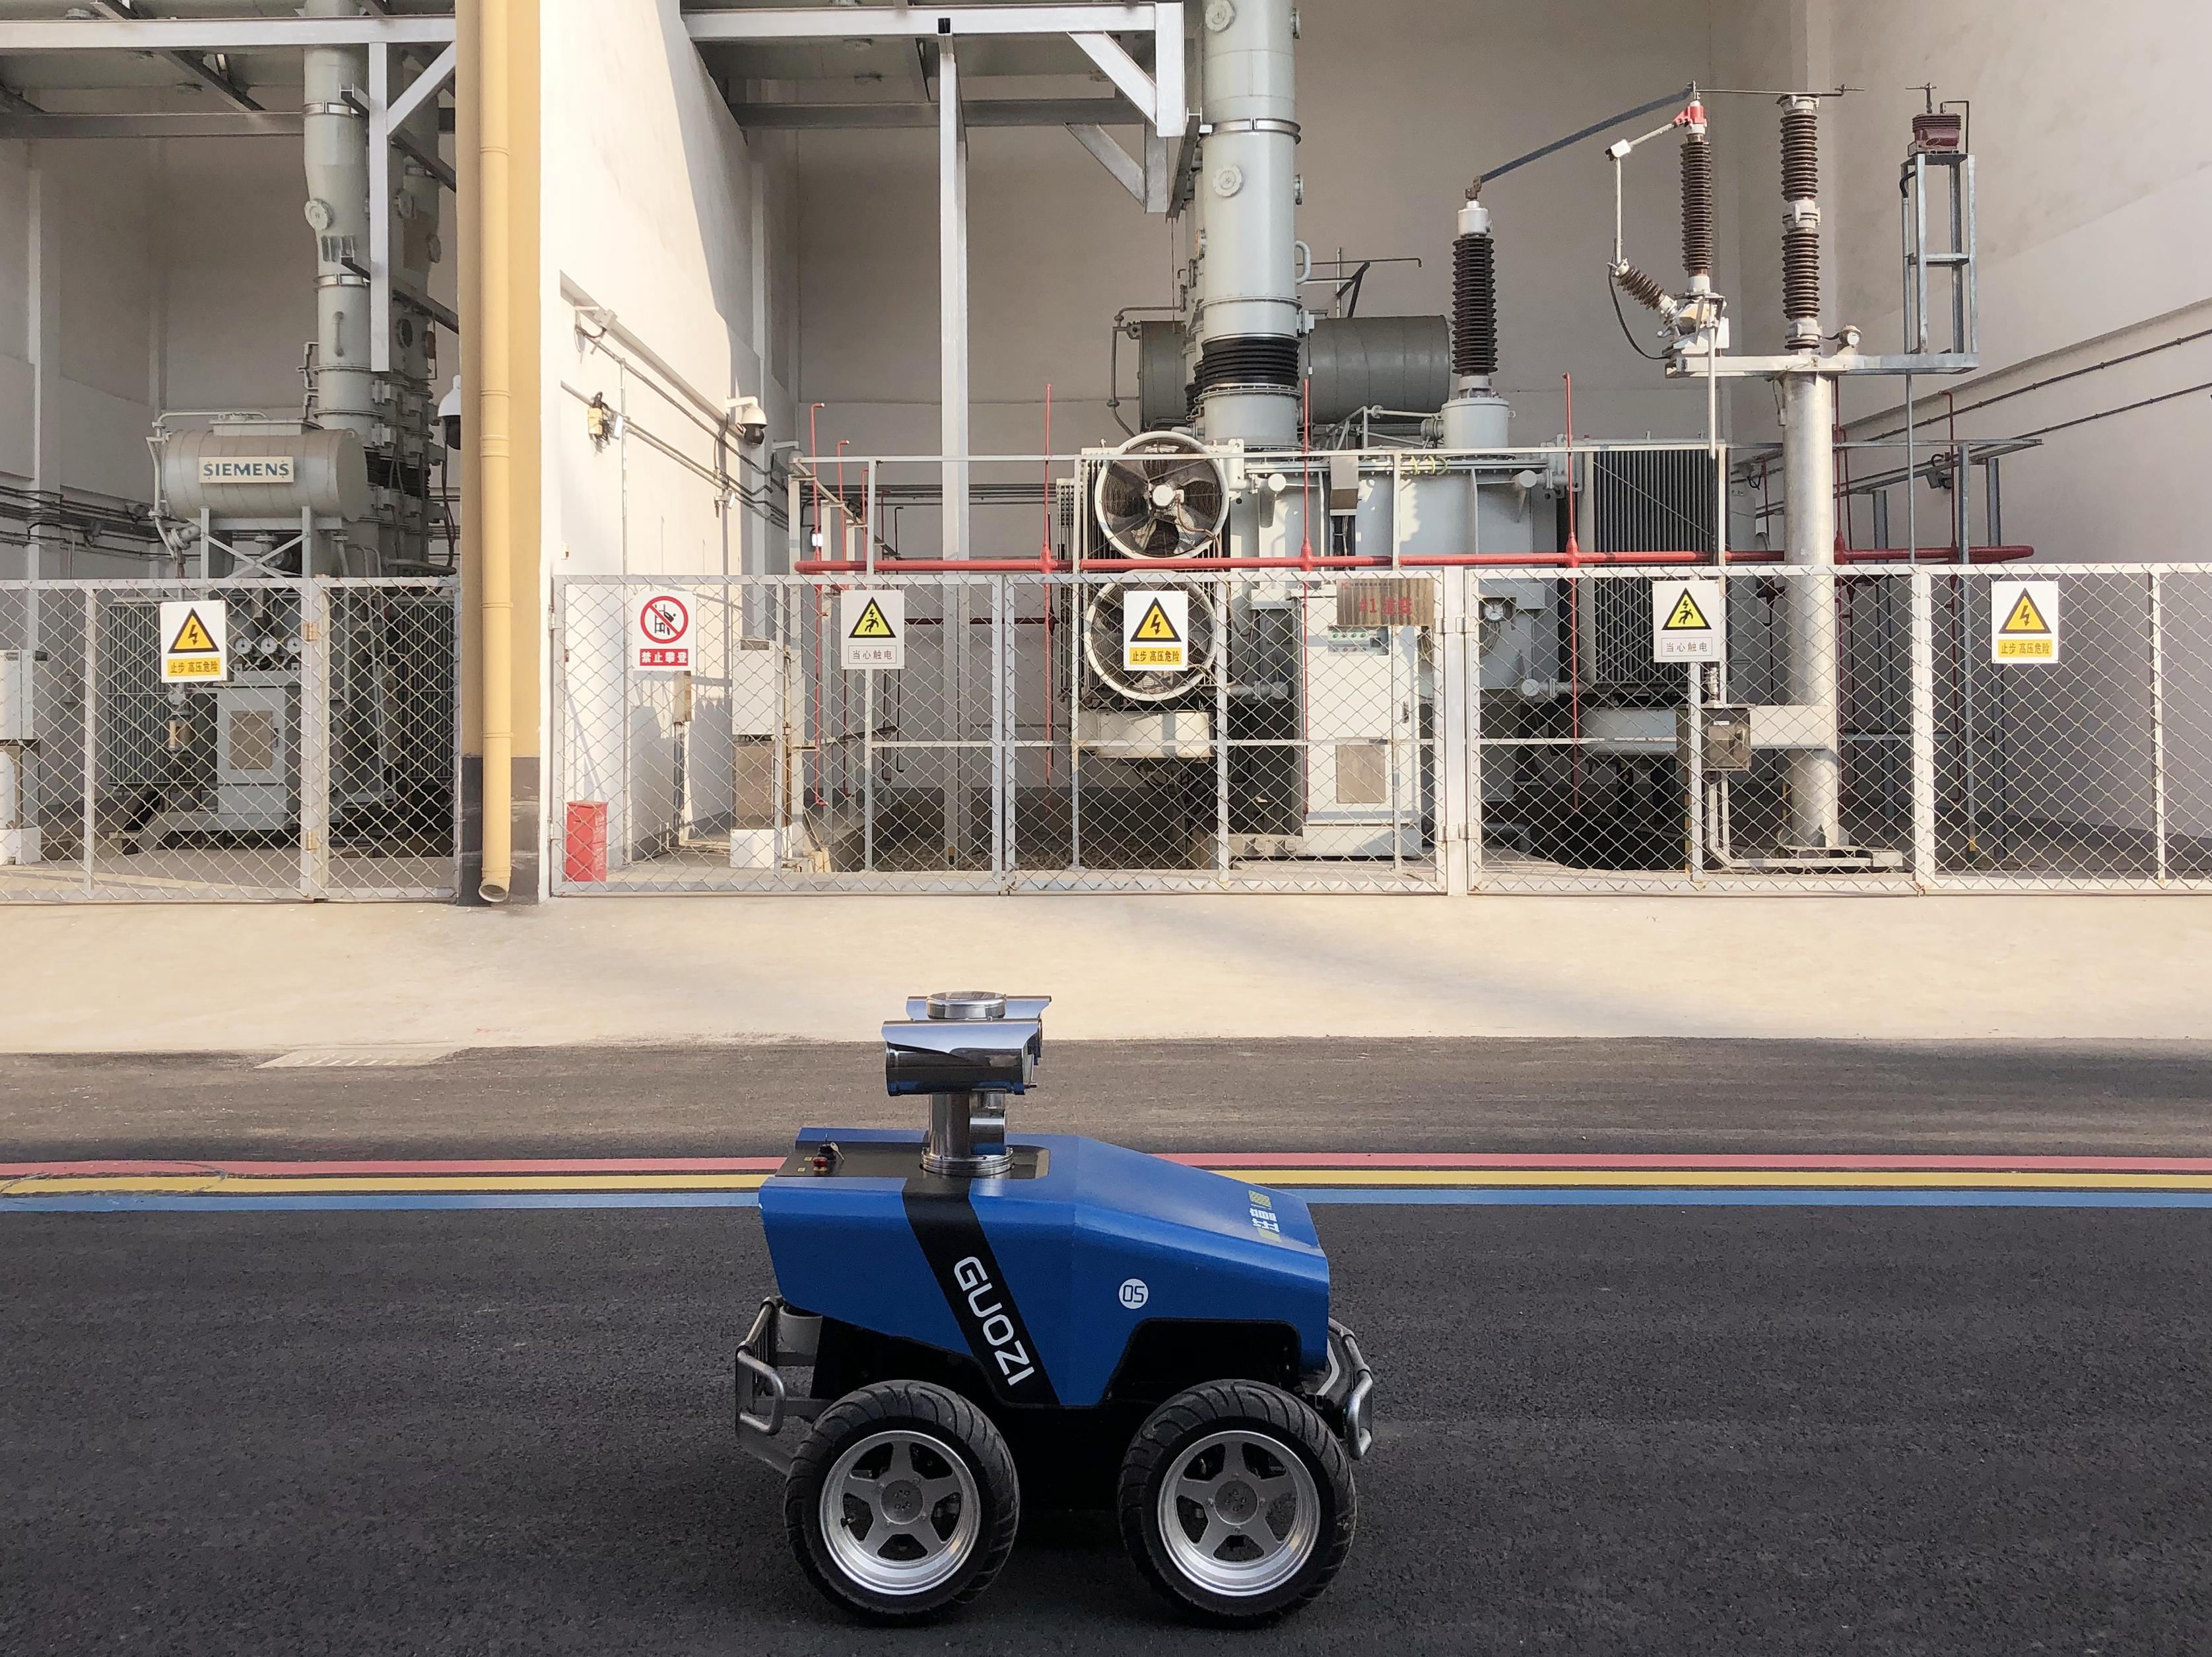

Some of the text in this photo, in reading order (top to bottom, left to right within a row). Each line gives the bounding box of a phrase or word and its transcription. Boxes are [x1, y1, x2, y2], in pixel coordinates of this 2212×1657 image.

[203, 463, 289, 477] SIEMENS
[1666, 642, 1708, 652] 当心触电
[2001, 642, 2050, 654] 止步 高压危险
[642, 651, 687, 663] 禁止攀登
[852, 649, 892, 659] 当心触电
[1132, 650, 1180, 662] 止步 高压危险
[170, 661, 218, 673] 止步 高压危险
[1122, 1285, 1145, 1302] 05
[954, 1256, 1034, 1386] GUOZI
